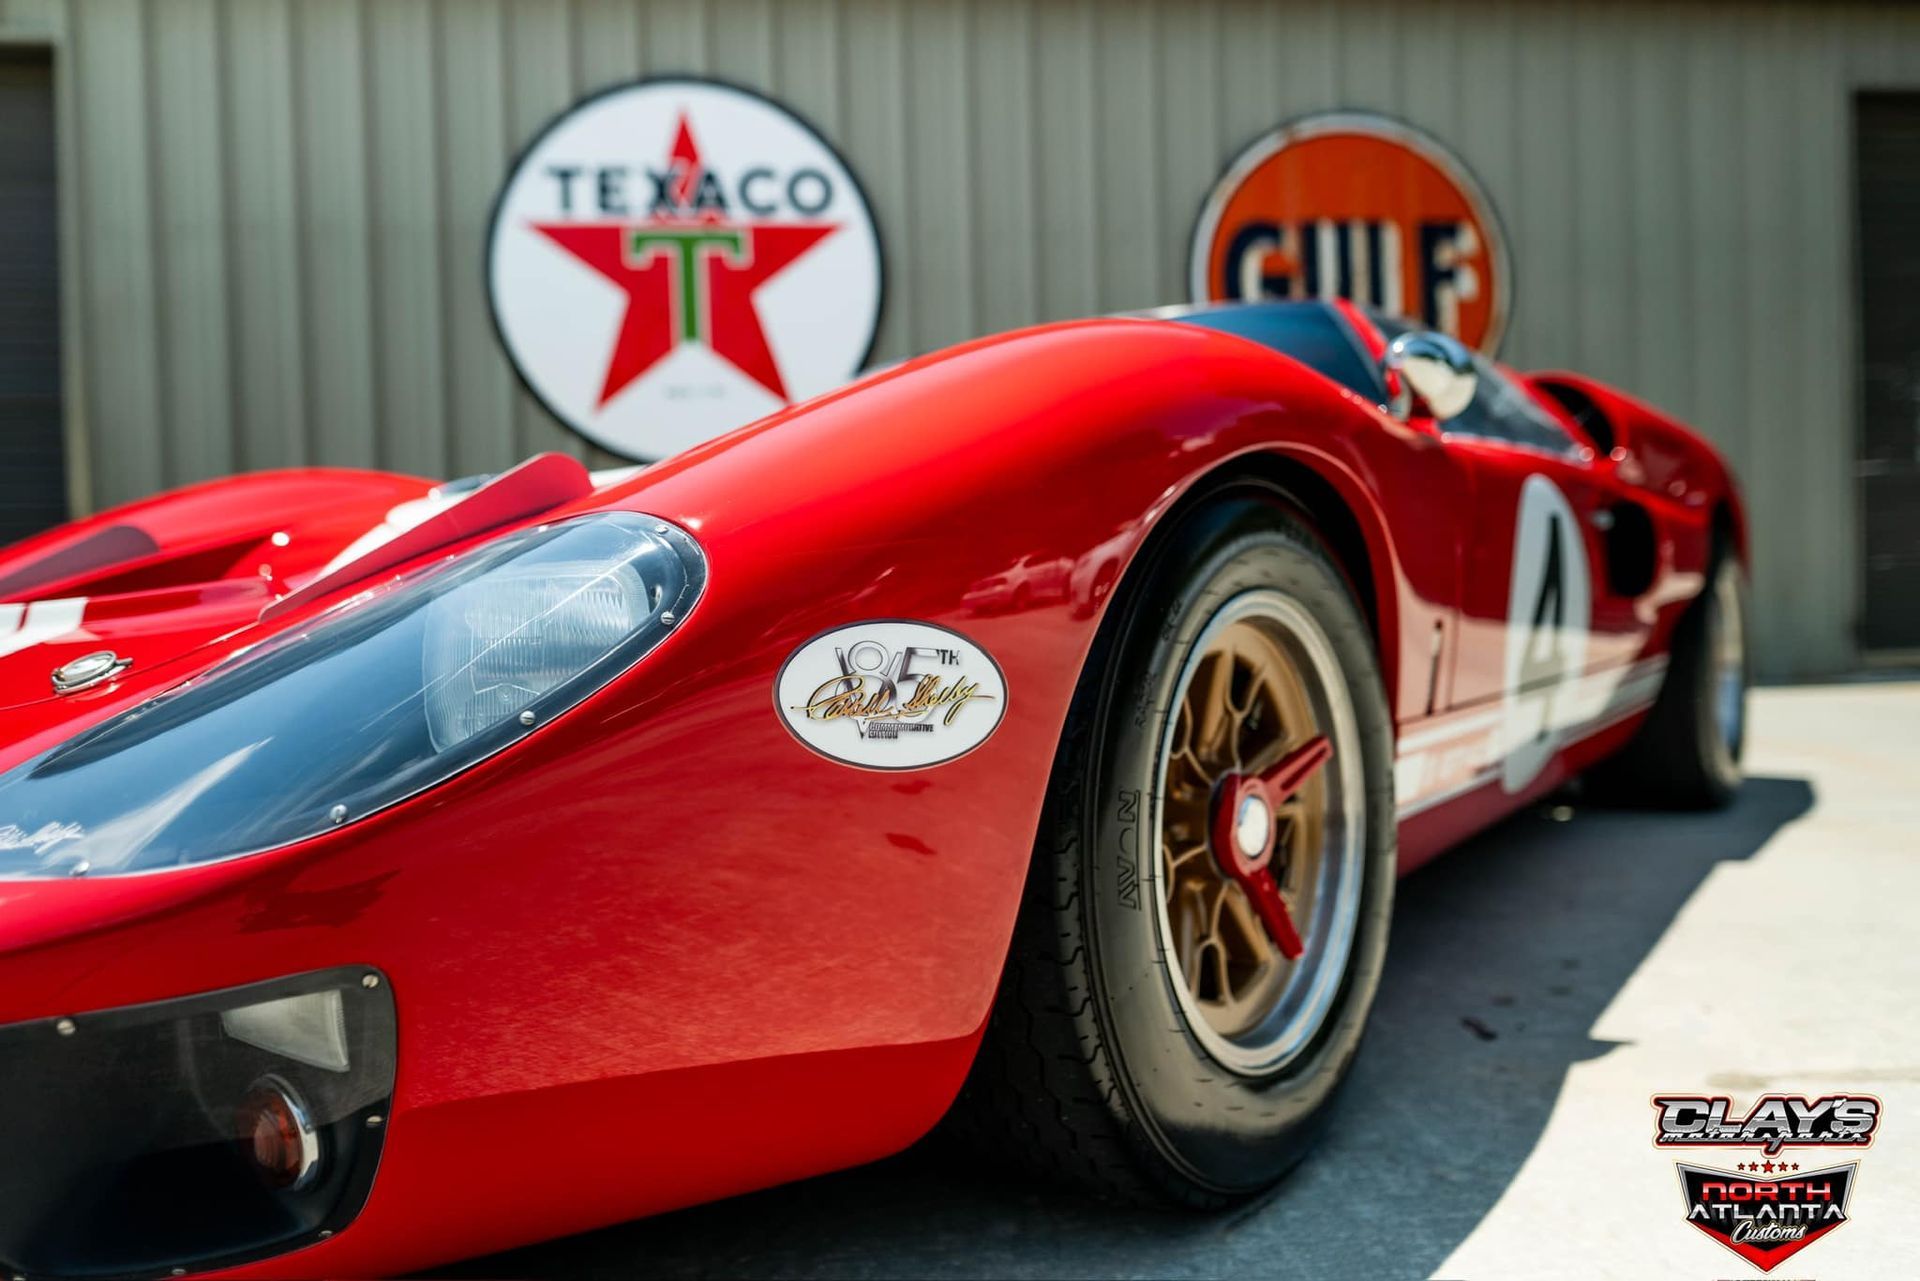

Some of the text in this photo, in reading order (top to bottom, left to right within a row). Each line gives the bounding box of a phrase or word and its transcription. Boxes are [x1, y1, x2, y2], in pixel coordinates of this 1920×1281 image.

[547, 165, 835, 215] TEXACO
[1224, 219, 1478, 333] GULF
[1517, 512, 1566, 743] 4
